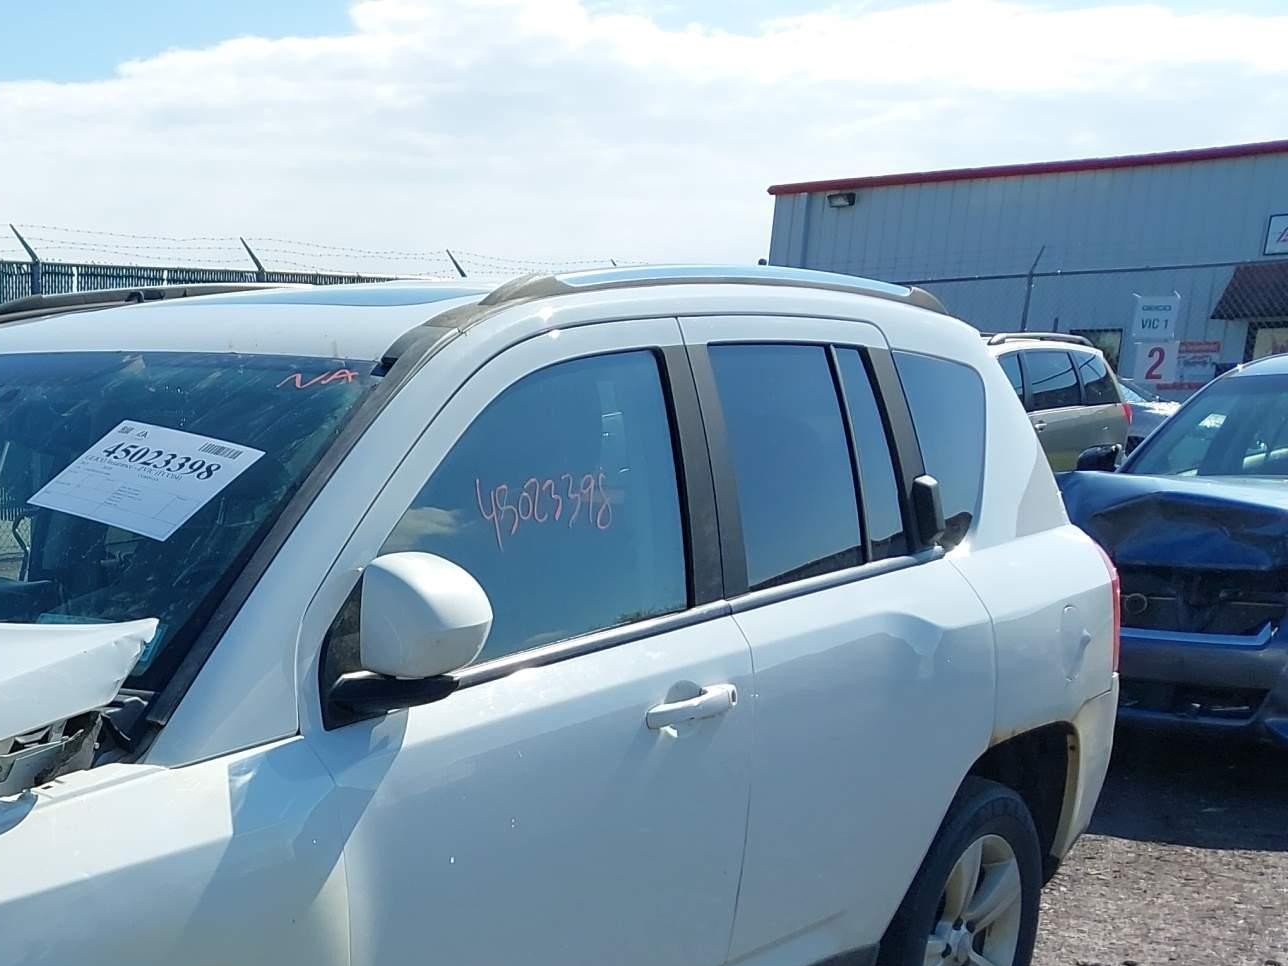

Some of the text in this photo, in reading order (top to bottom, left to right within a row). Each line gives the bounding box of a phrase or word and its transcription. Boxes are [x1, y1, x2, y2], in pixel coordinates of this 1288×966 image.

[1141, 318, 1169, 329] VIC 1
[1144, 346, 1166, 380] 2
[103, 441, 222, 481] 45023398
